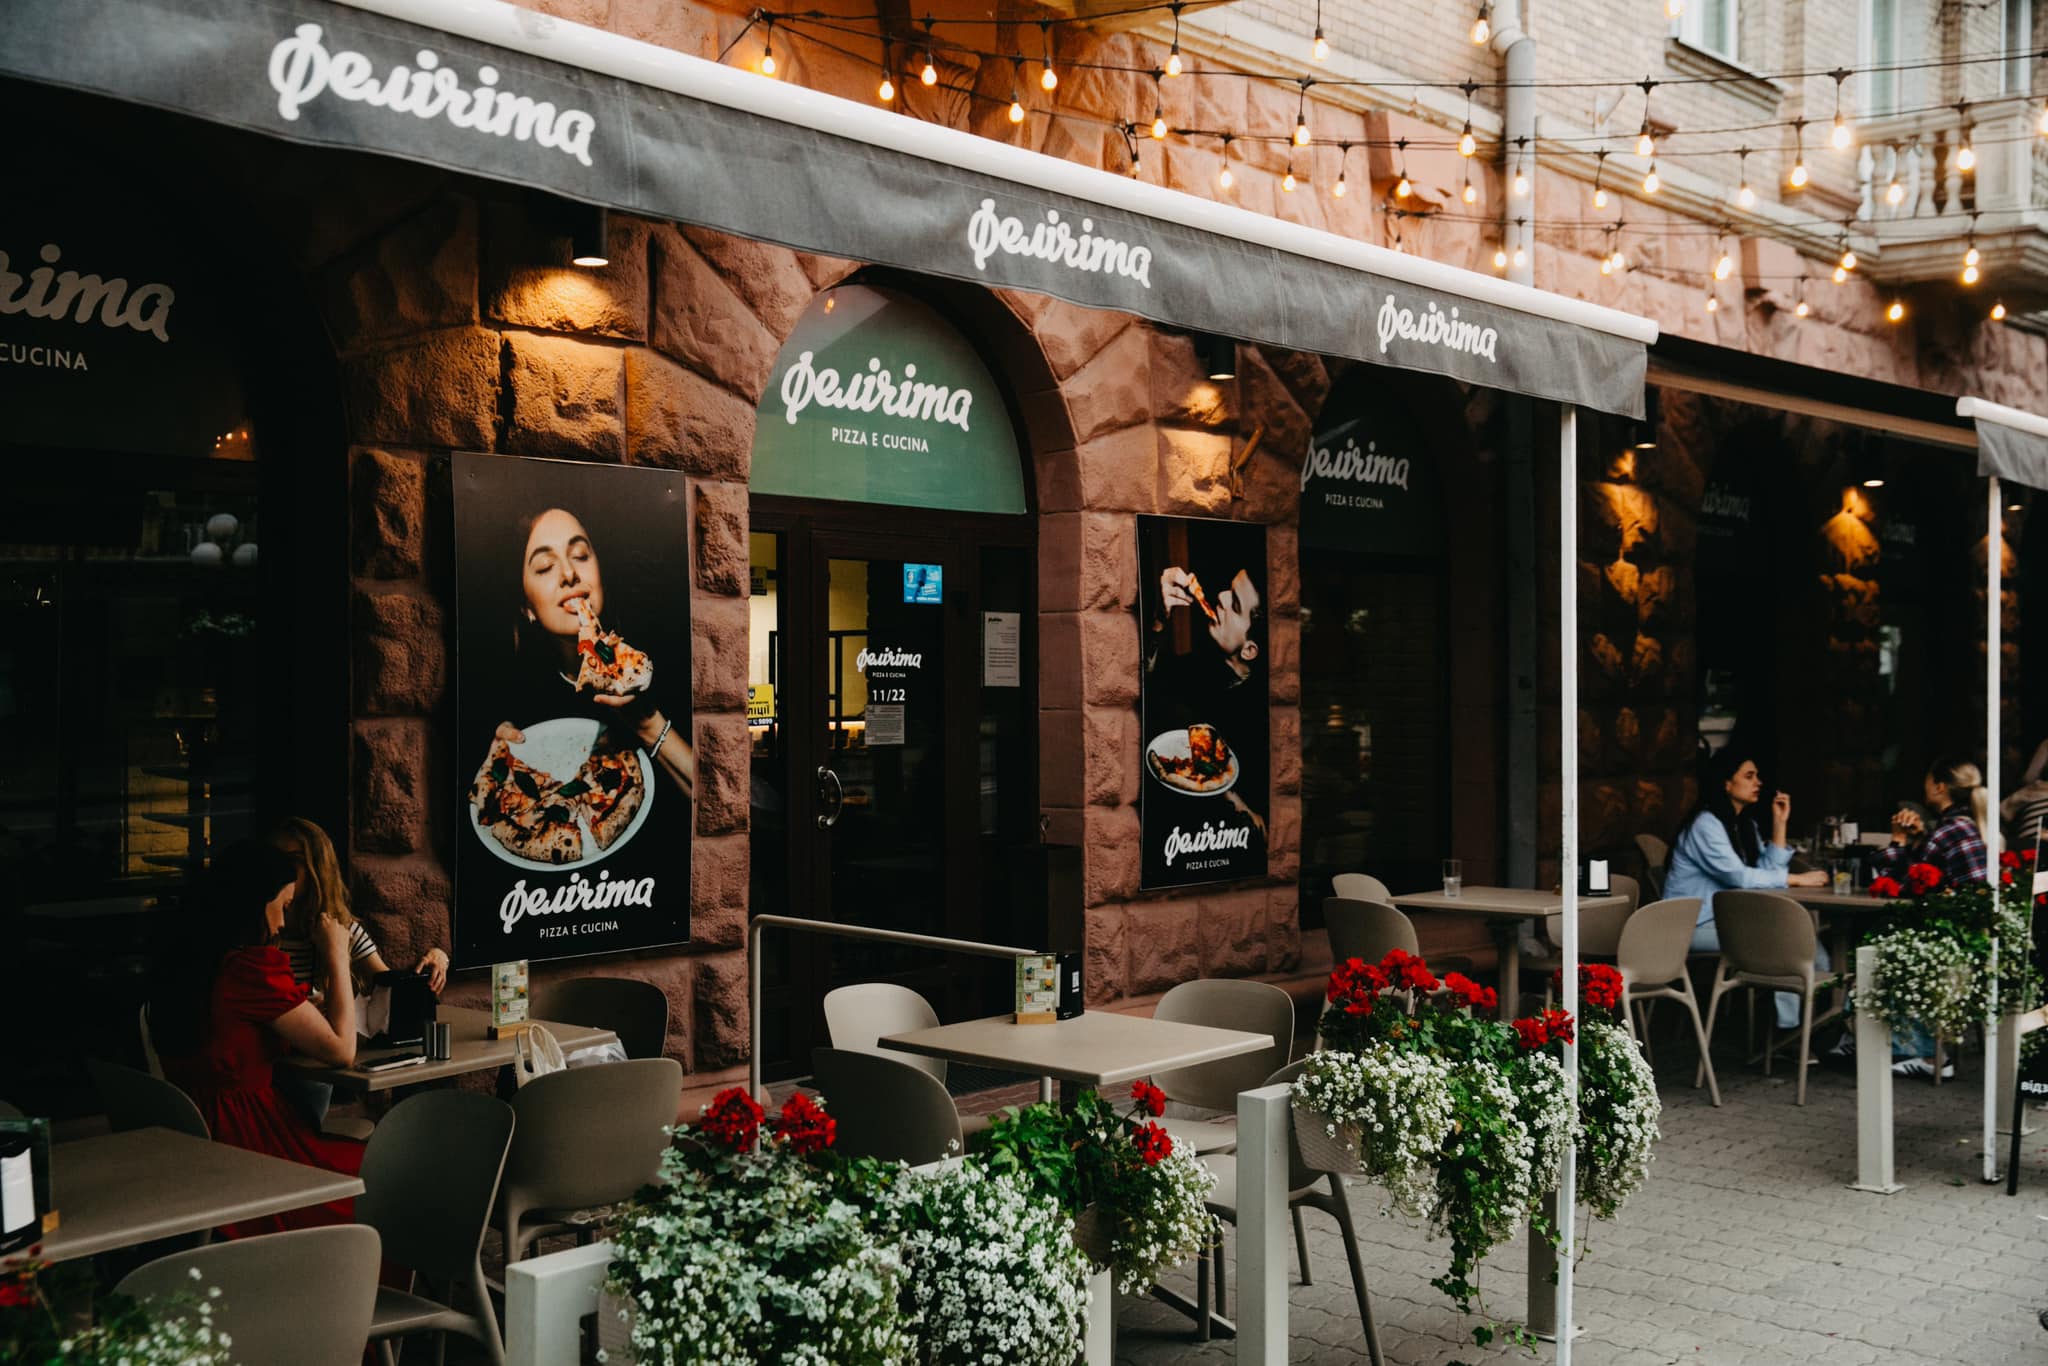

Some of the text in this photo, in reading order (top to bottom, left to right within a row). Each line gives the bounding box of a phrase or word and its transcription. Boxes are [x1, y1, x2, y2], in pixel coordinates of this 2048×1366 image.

[831, 427, 929, 453] PIZZA E CUCINA
[1325, 493, 1384, 509] PIZZA E CUCINA
[872, 688, 906, 702] 11/22
[1186, 861, 1203, 870] PIZZA
[1208, 858, 1230, 867] CUCINA
[540, 920, 619, 938] PIZZA E CUCINA
